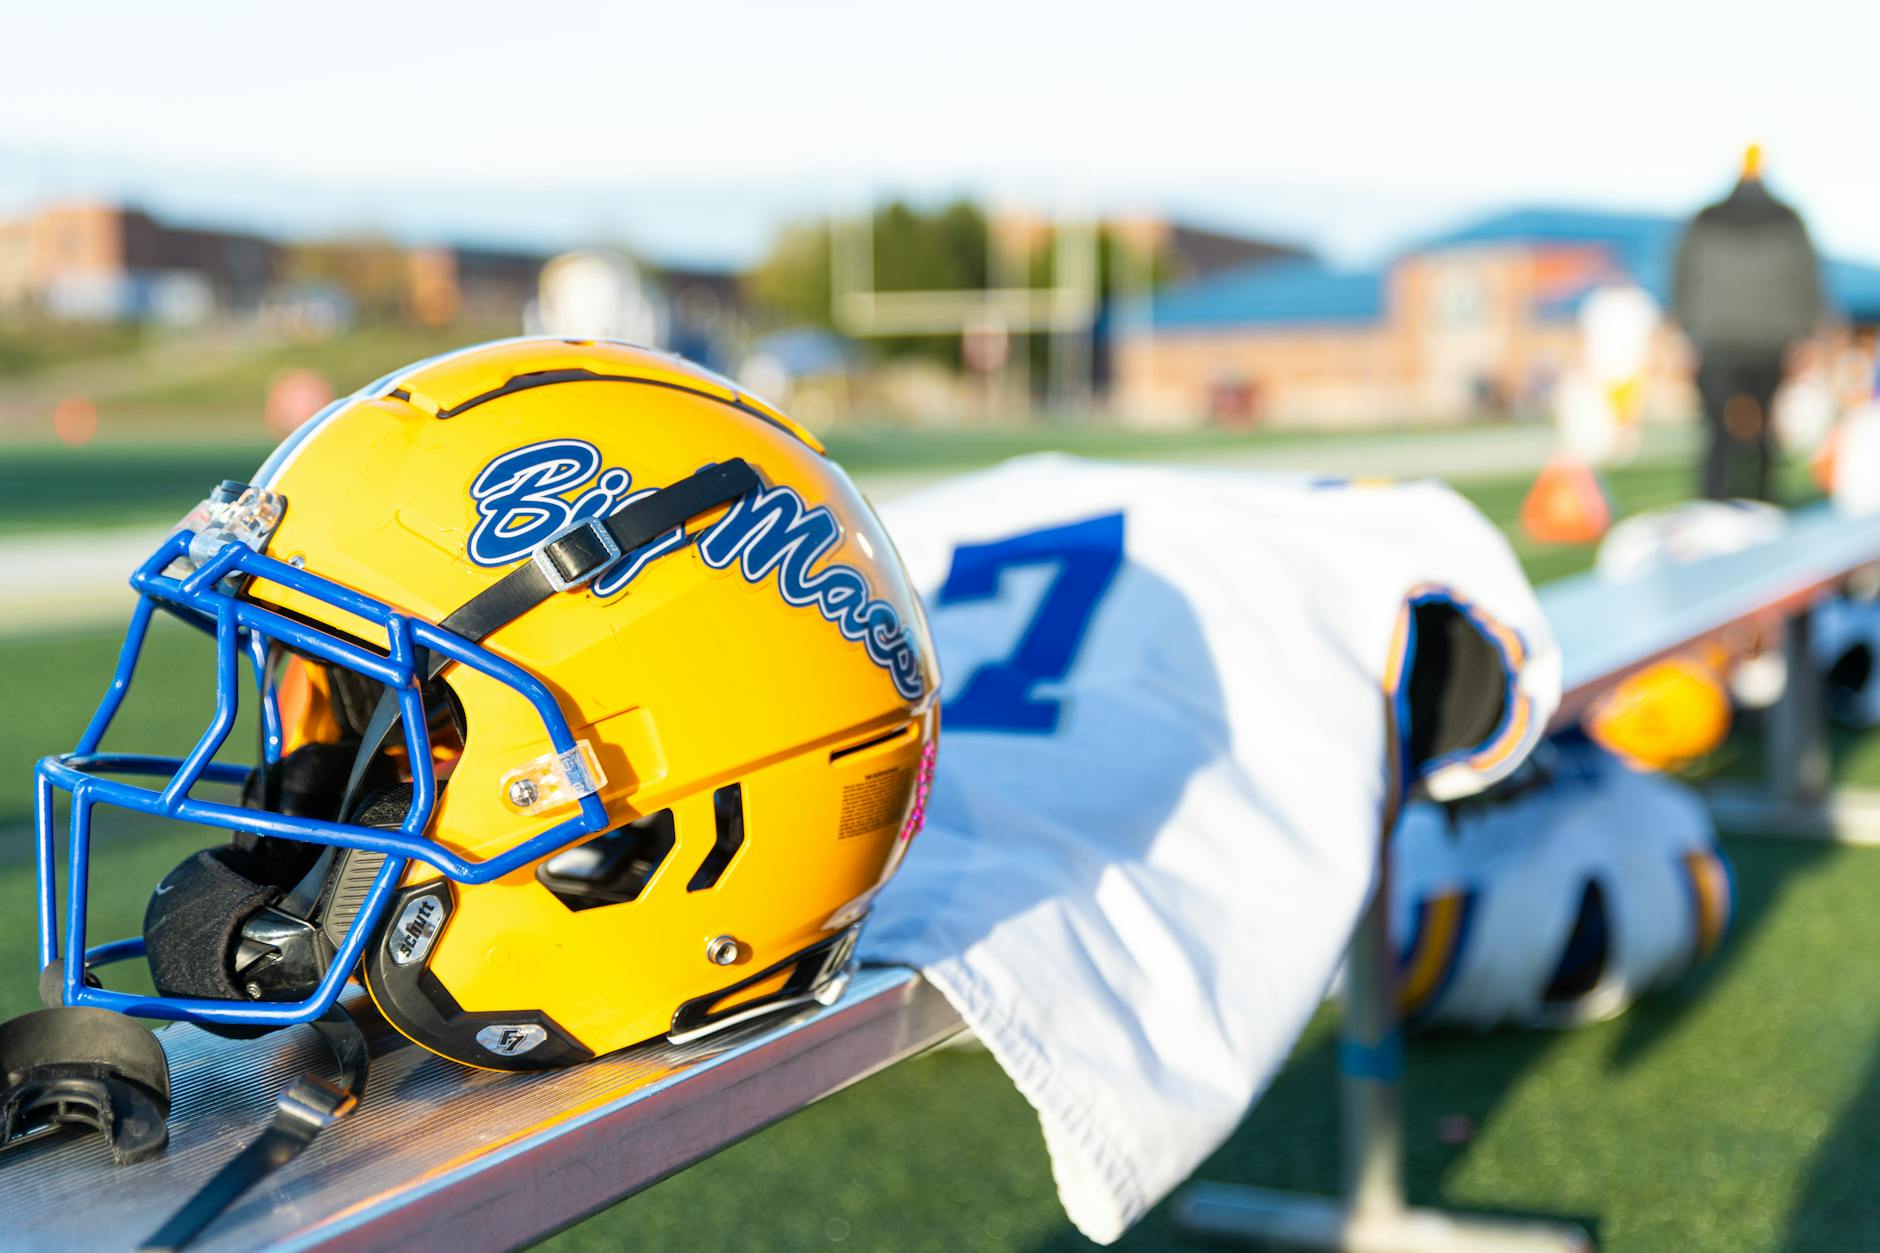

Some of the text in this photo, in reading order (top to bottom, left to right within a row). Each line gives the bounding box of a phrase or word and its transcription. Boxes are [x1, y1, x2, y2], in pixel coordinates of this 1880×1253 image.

[936, 511, 1124, 735] 7
[399, 900, 435, 958] schutt
[498, 1027, 527, 1053] F7
